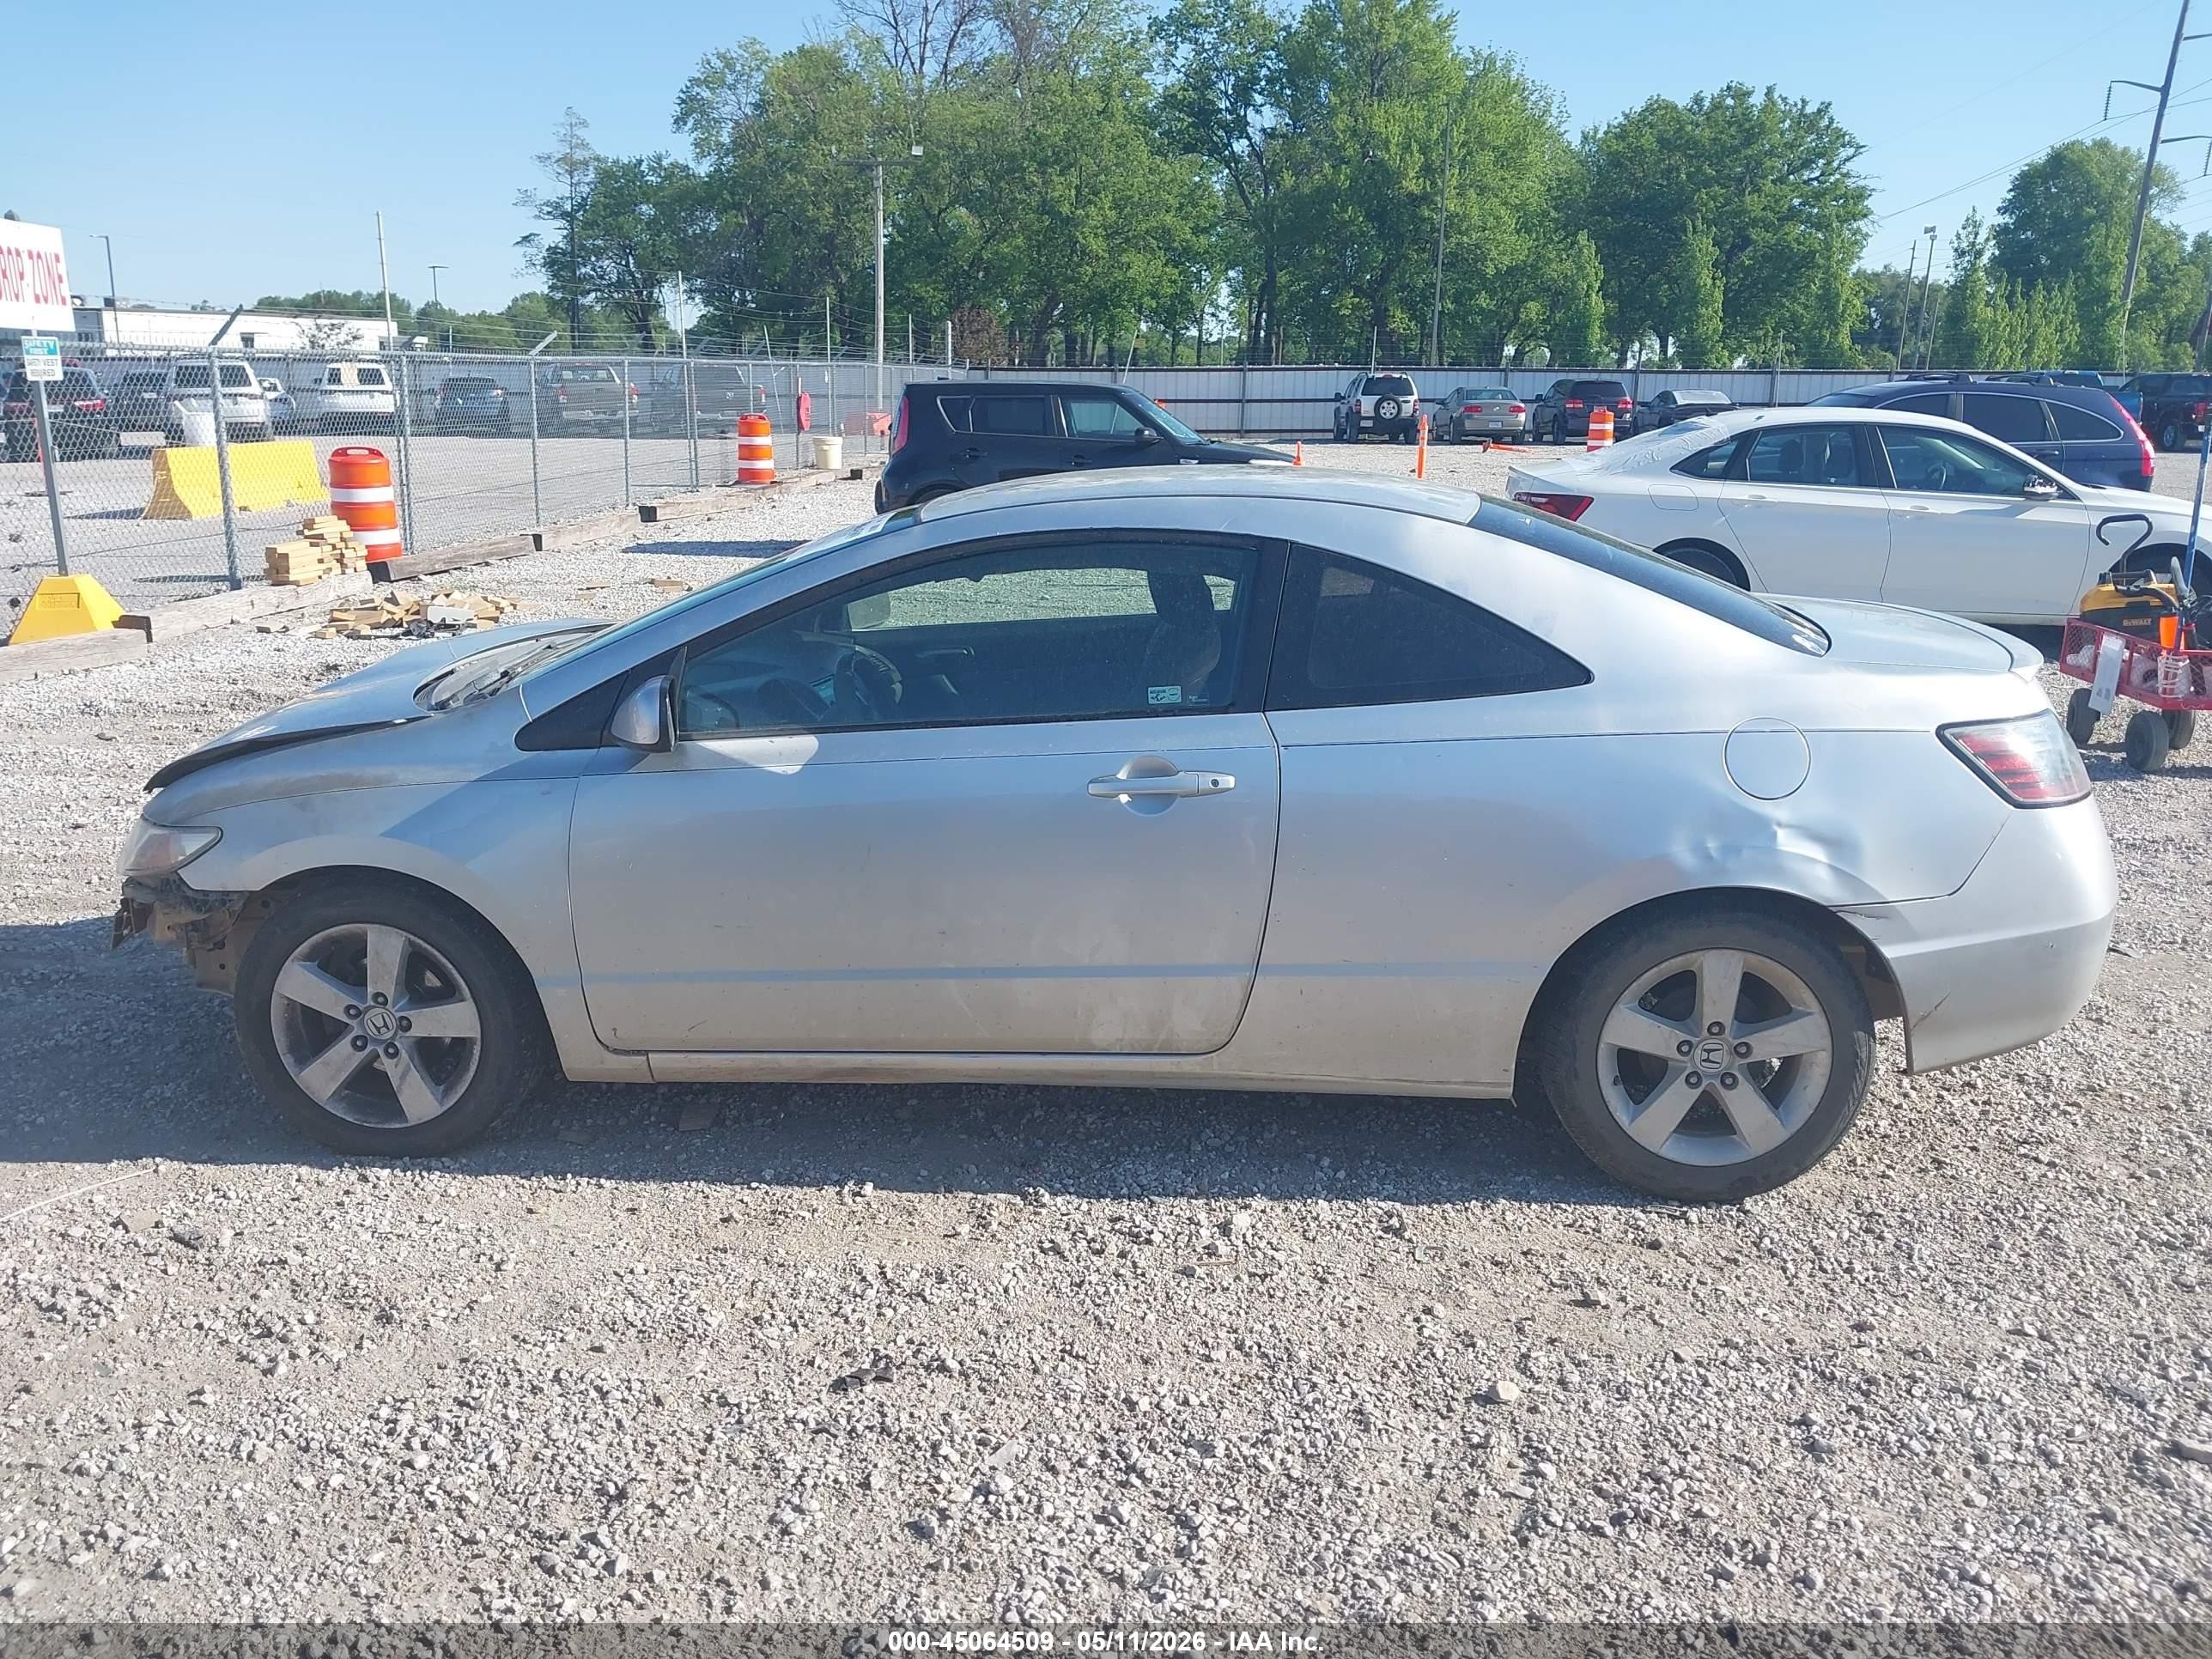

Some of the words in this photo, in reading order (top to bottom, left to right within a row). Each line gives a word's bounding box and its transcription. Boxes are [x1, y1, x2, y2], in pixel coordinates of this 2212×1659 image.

[0, 245, 24, 302] ROP
[27, 249, 67, 306] ZONE
[42, 358, 58, 367] VEST
